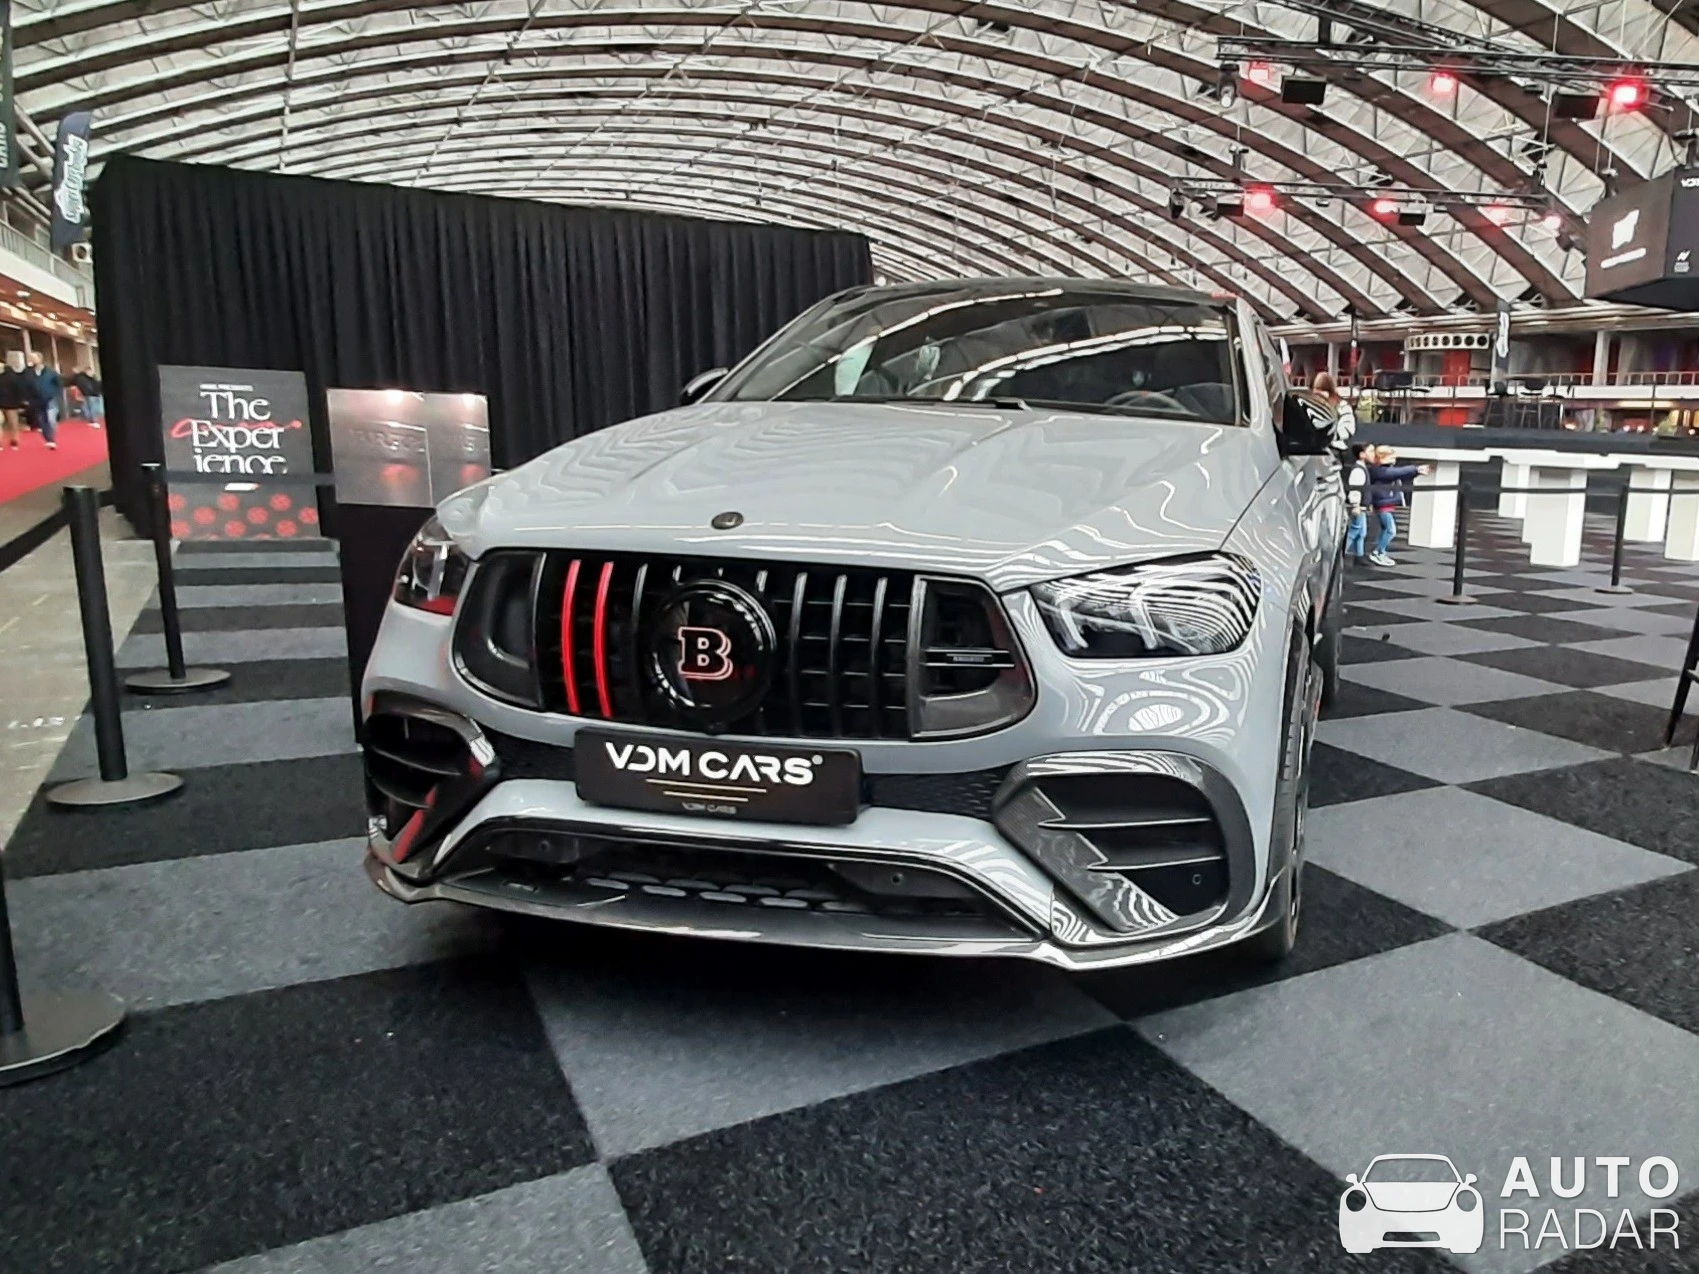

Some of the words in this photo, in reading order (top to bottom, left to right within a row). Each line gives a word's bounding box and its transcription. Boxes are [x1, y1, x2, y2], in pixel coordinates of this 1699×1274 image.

[200, 391, 271, 420] The
[191, 419, 285, 454] Exper
[677, 626, 734, 681] B
[604, 741, 692, 777] VDM
[698, 751, 814, 786] CARS
